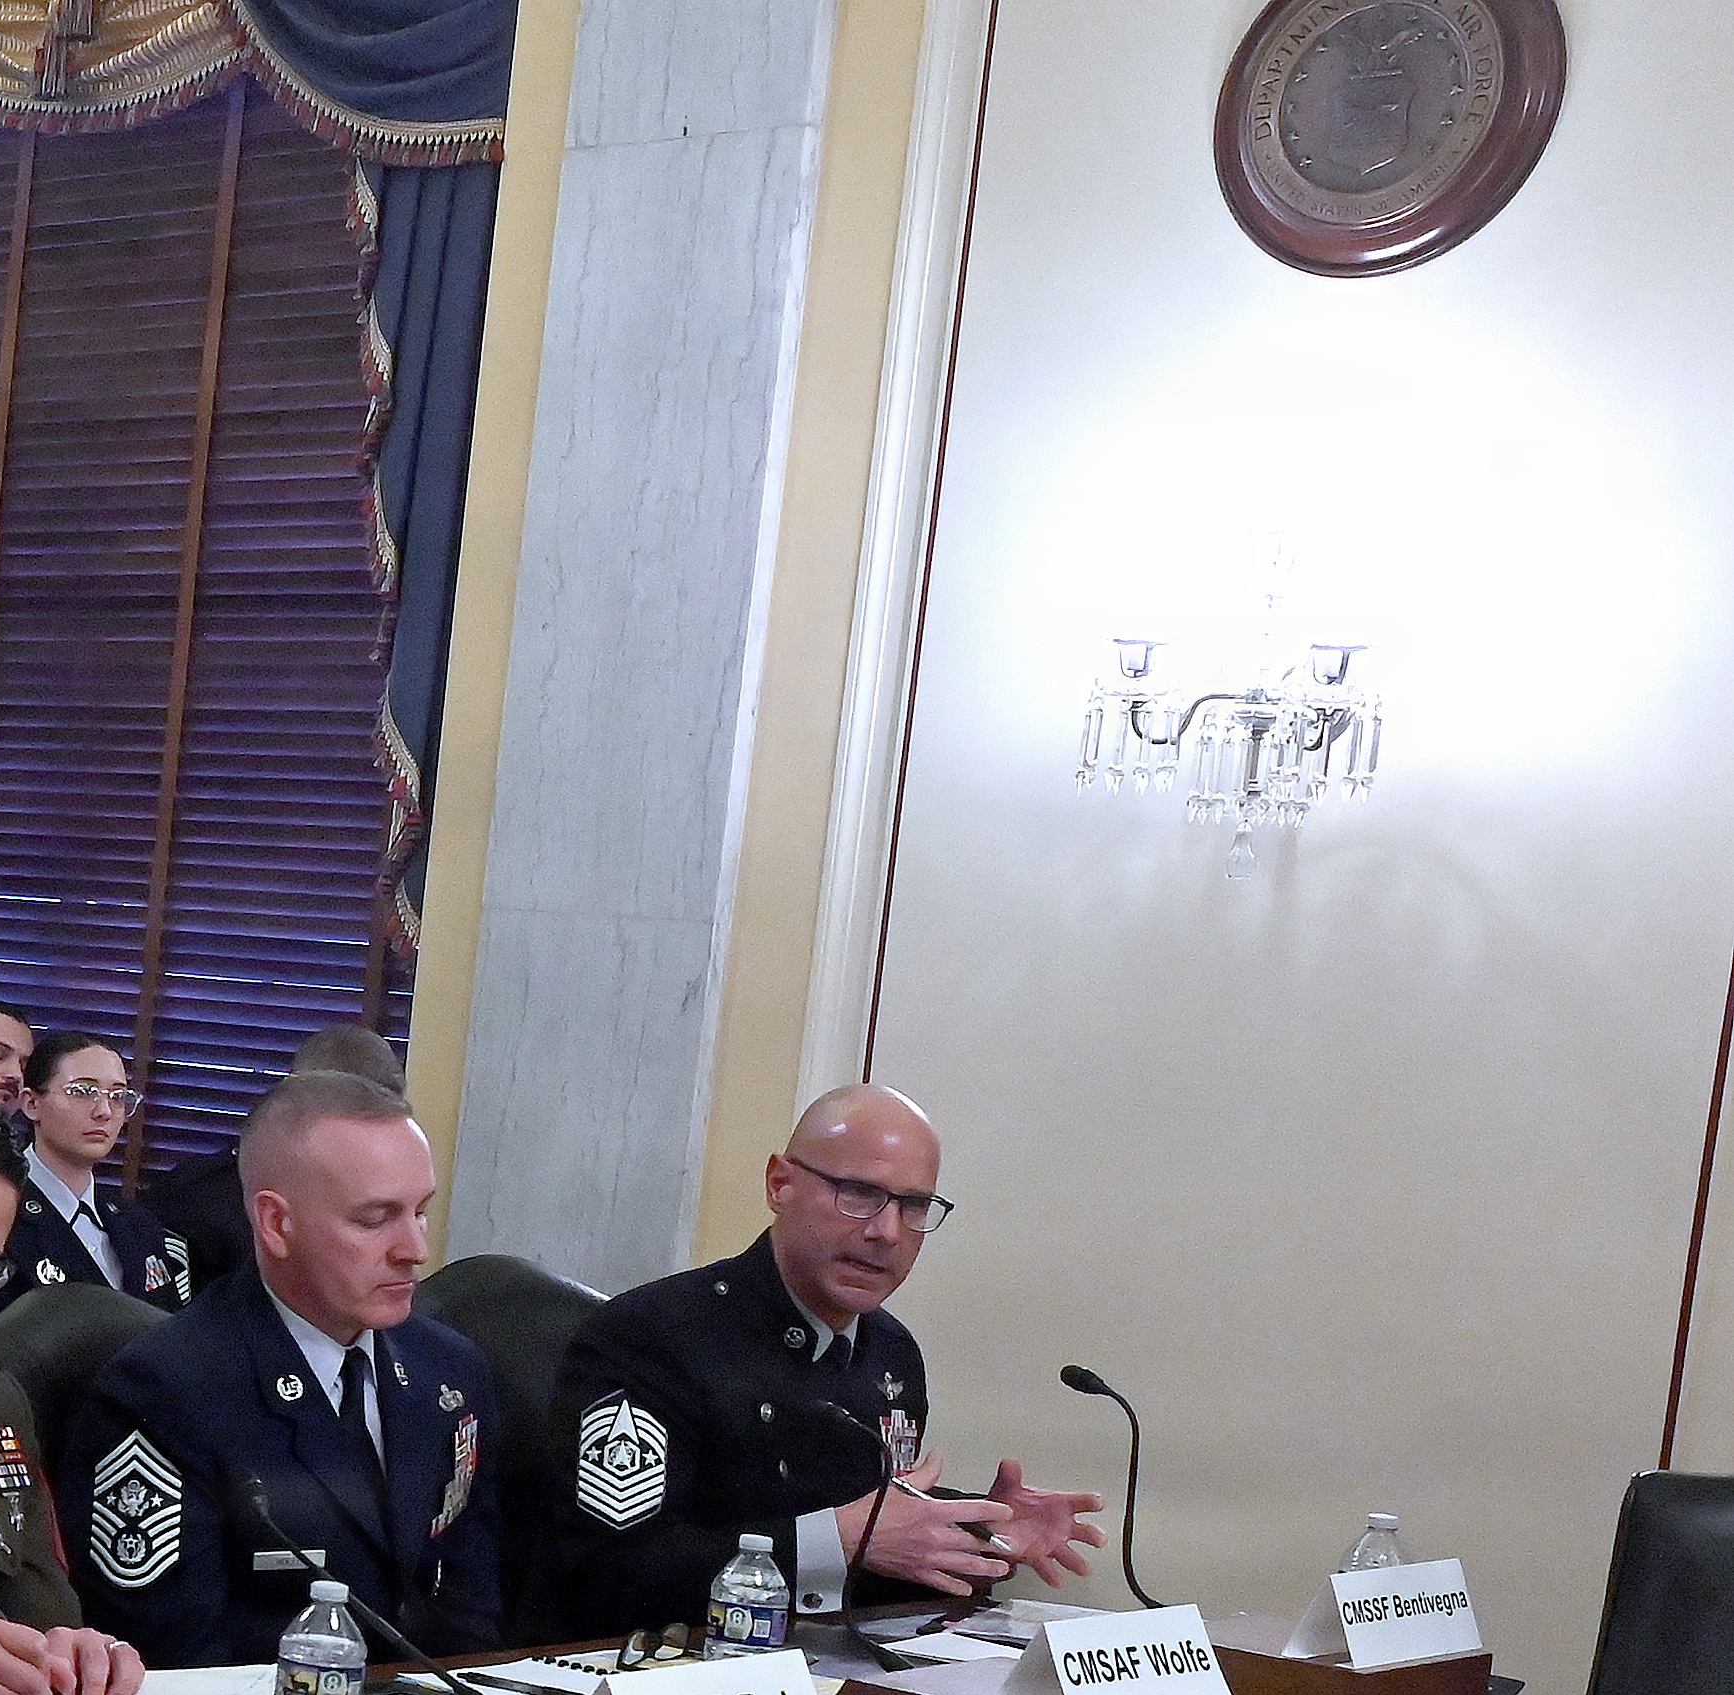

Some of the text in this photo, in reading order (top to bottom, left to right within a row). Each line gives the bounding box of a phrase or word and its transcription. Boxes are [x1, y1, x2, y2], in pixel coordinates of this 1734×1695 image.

[1342, 1590, 1468, 1626] CMSSF Bentivegna
[1063, 1640, 1211, 1686] CMSAF Wolfe
